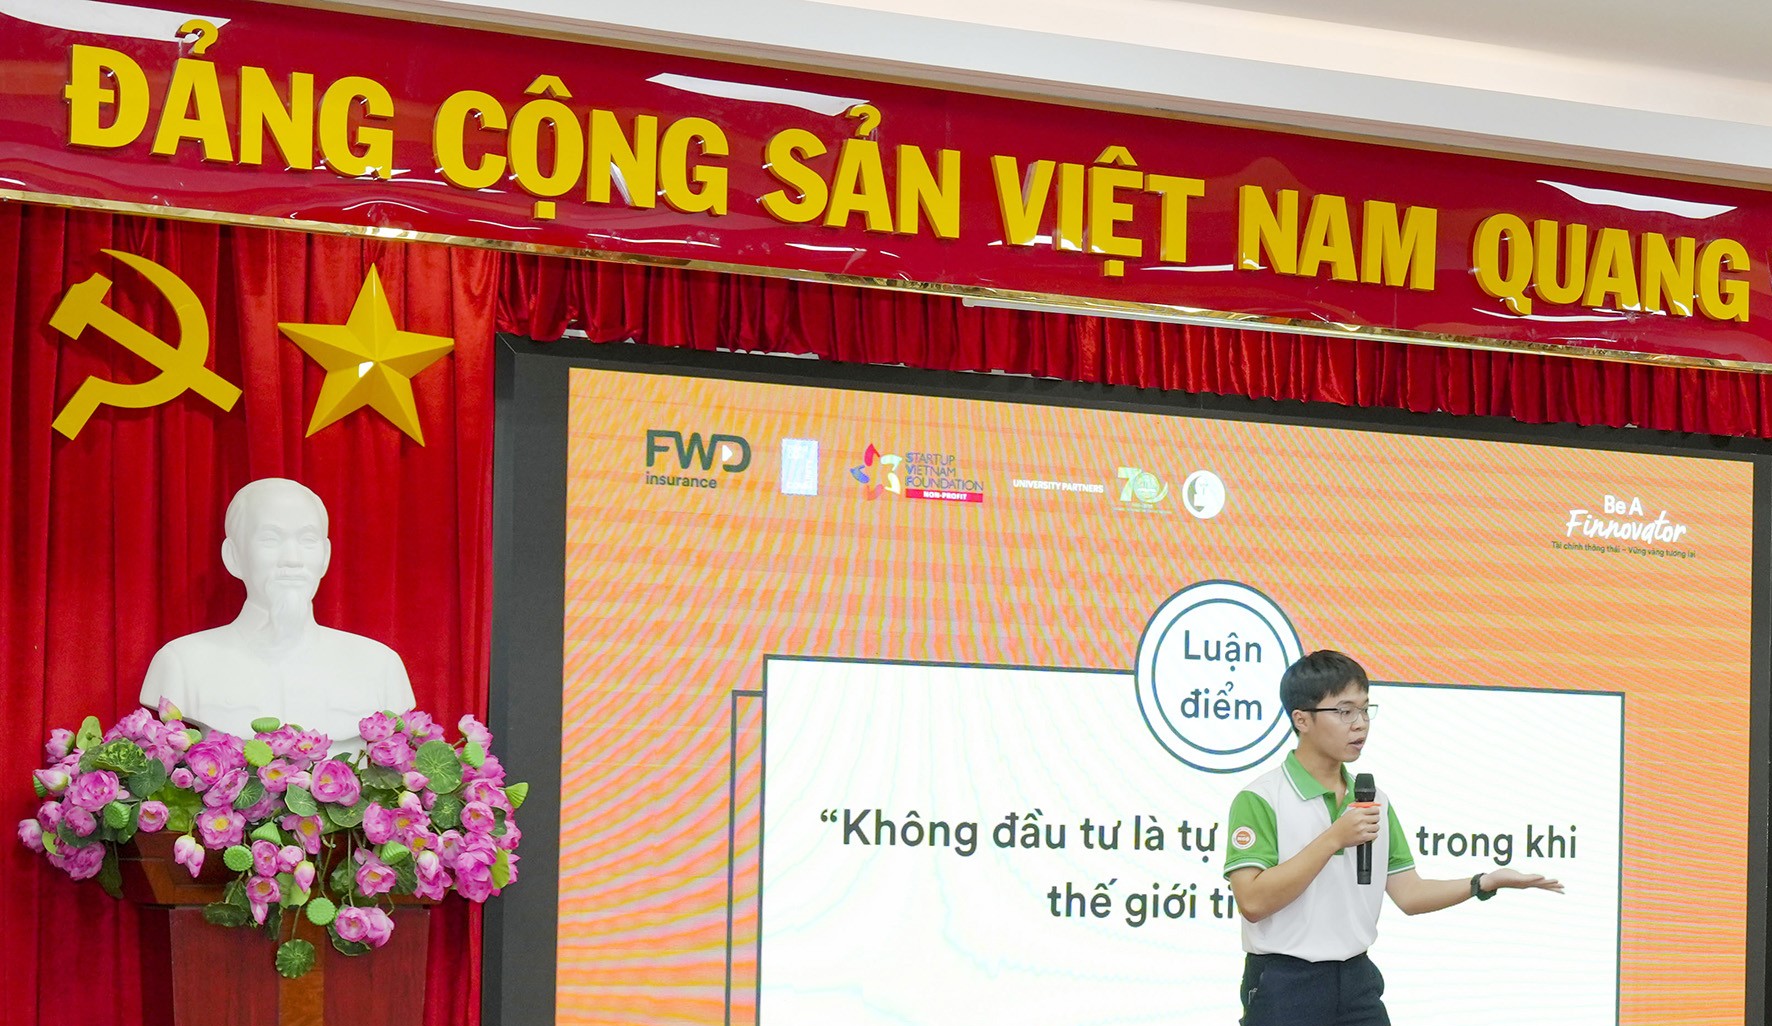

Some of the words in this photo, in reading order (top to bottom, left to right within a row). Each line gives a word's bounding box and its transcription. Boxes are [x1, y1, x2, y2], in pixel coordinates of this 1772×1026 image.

[65, 20, 394, 181] ĐẢNG
[434, 75, 730, 220] CỘNG
[762, 104, 962, 239] SẢN
[993, 146, 1205, 277] VIỆT
[1239, 185, 1437, 290] NAM
[1473, 214, 1751, 322] QUANG
[646, 429, 752, 473] FWD
[905, 452, 956, 465] STARTUP
[646, 470, 717, 489] insurance
[905, 465, 957, 477] VIETNAM
[905, 476, 984, 491] FOUNDATION
[923, 490, 968, 500] NON-PROFIT
[1013, 479, 1061, 491] UNIVERSITY
[1061, 482, 1104, 493] PARTNERS
[1604, 494, 1627, 515] Be
[1628, 497, 1644, 517] A
[1565, 509, 1687, 545] Finnovator
[1184, 629, 1264, 672] Luận
[1179, 683, 1264, 723] điểm
[820, 809, 979, 857] “Không
[992, 807, 1067, 851] đầu
[1079, 818, 1123, 851] tư
[1134, 815, 1165, 852] là
[1177, 820, 1220, 863] tự
[1416, 824, 1513, 866] trong
[1526, 824, 1577, 859] khi
[1047, 876, 1119, 919] thế
[1125, 881, 1198, 928] giới
